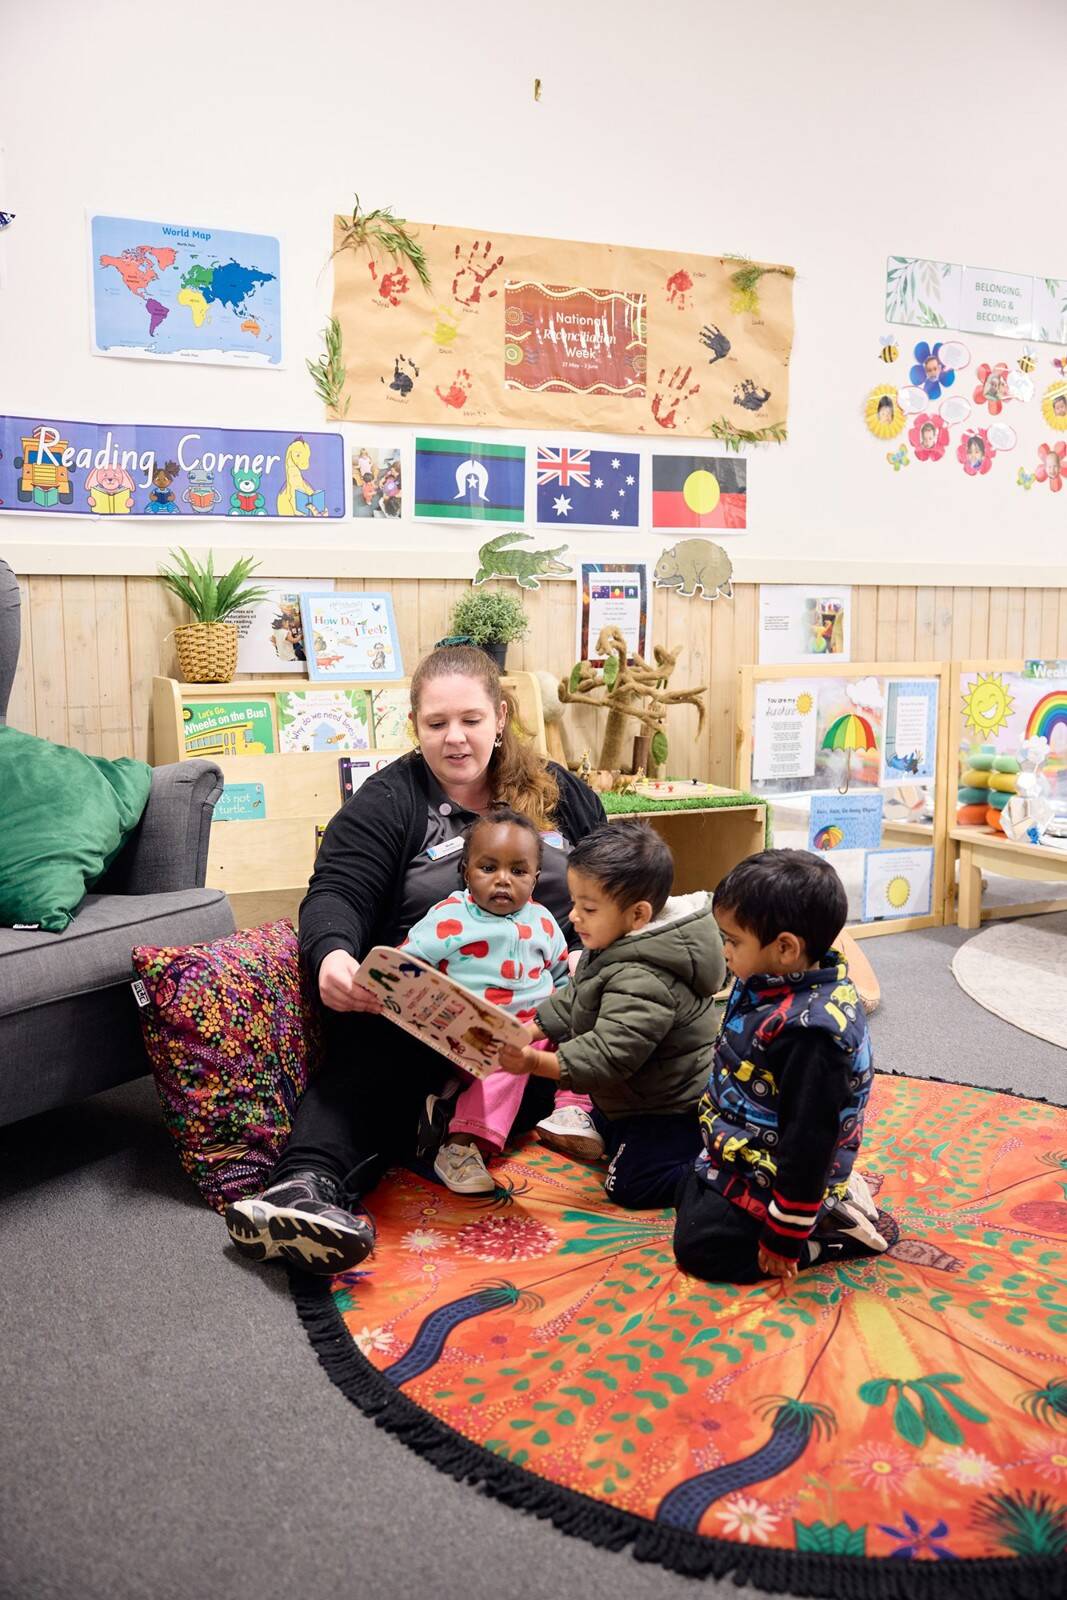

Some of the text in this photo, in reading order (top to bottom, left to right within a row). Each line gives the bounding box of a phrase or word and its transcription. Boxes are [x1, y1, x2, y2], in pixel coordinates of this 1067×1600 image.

[162, 226, 211, 241] World Map
[982, 297, 1014, 310] BEING &
[556, 311, 604, 326] National
[976, 311, 1019, 326] BECOMING
[543, 328, 617, 345] Reconciliation
[565, 346, 596, 360] Week
[36, 426, 281, 489] Reading Corner
[314, 615, 355, 626] How Do
[354, 623, 388, 637] I Feel?
[184, 707, 267, 736] Wheels on the Bus!
[197, 709, 214, 719] Let's
[291, 725, 305, 740] Why
[302, 717, 311, 726] do
[311, 712, 321, 720] we
[323, 712, 343, 722] need
[233, 793, 251, 803] not
